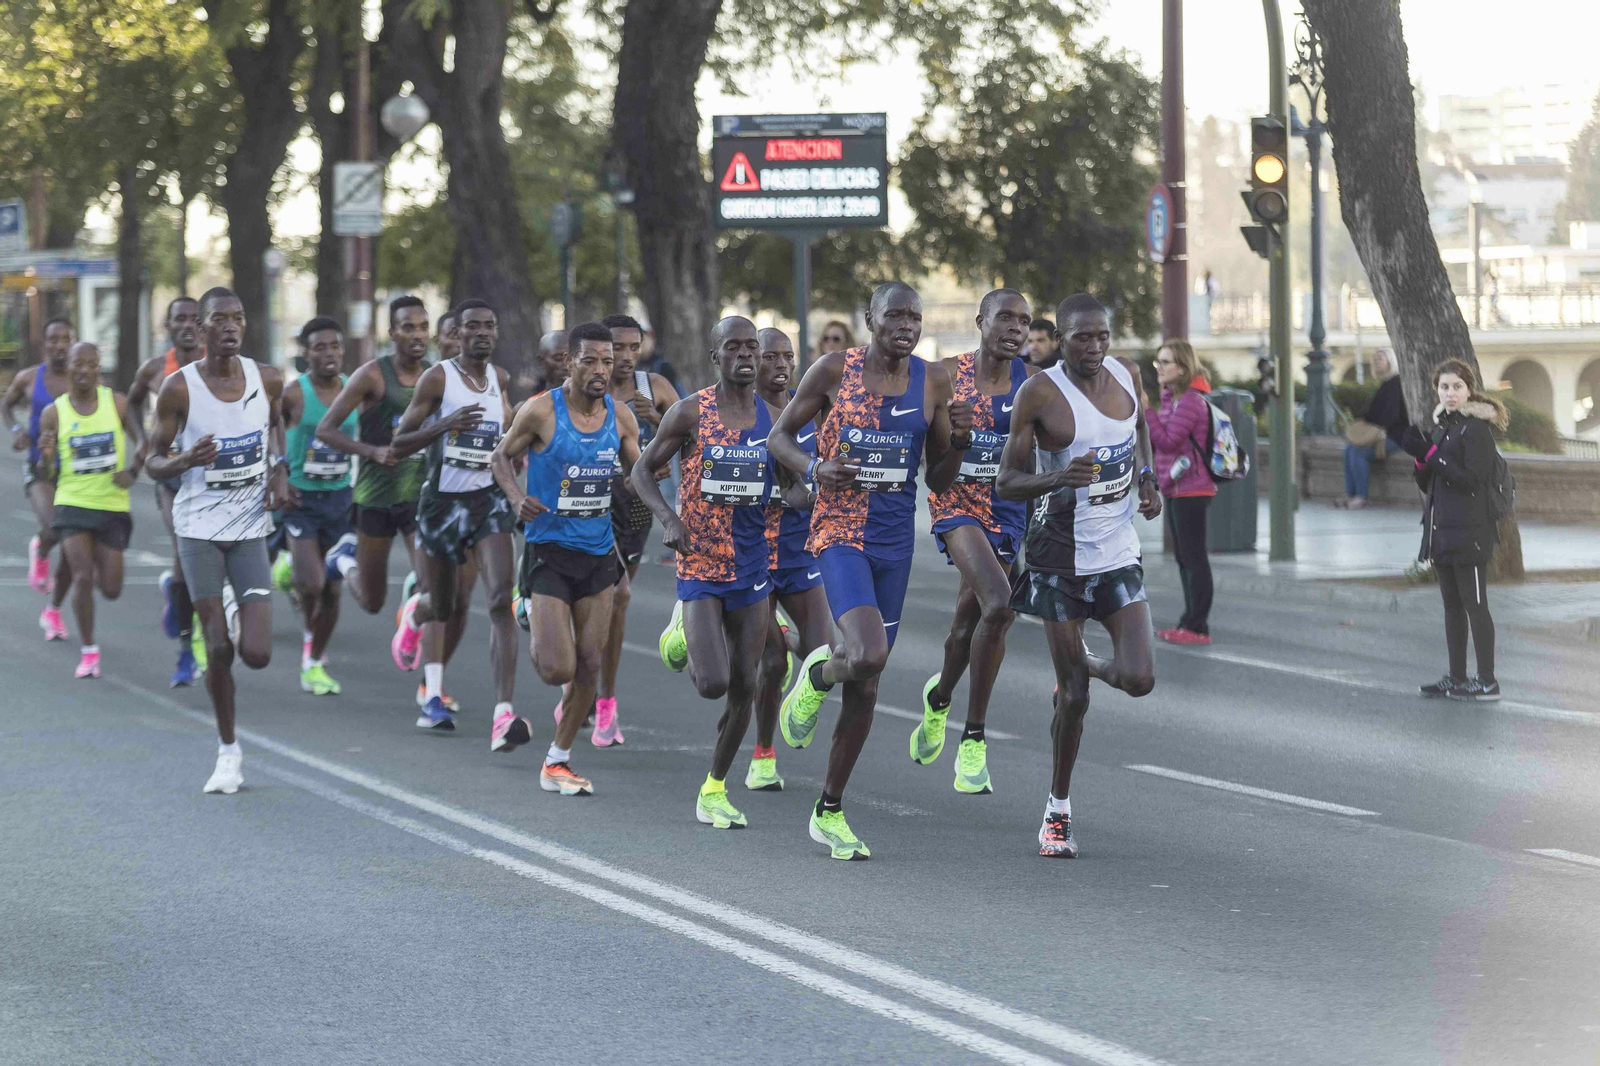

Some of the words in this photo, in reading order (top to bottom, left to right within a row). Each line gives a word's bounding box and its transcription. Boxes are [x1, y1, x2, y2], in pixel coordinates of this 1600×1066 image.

[225, 435, 259, 449] ZURICH
[472, 438, 485, 447] 12
[864, 433, 903, 444] ZURICH
[726, 449, 760, 459] ZURICH
[867, 453, 882, 463] 20
[981, 451, 993, 461] 21
[231, 454, 246, 465] 18
[580, 468, 611, 477] ZURICH
[732, 467, 740, 477] 5
[1119, 463, 1126, 473] 9
[858, 470, 885, 479] HENRY
[583, 484, 596, 494] 85
[720, 484, 747, 492] KIPTUM
